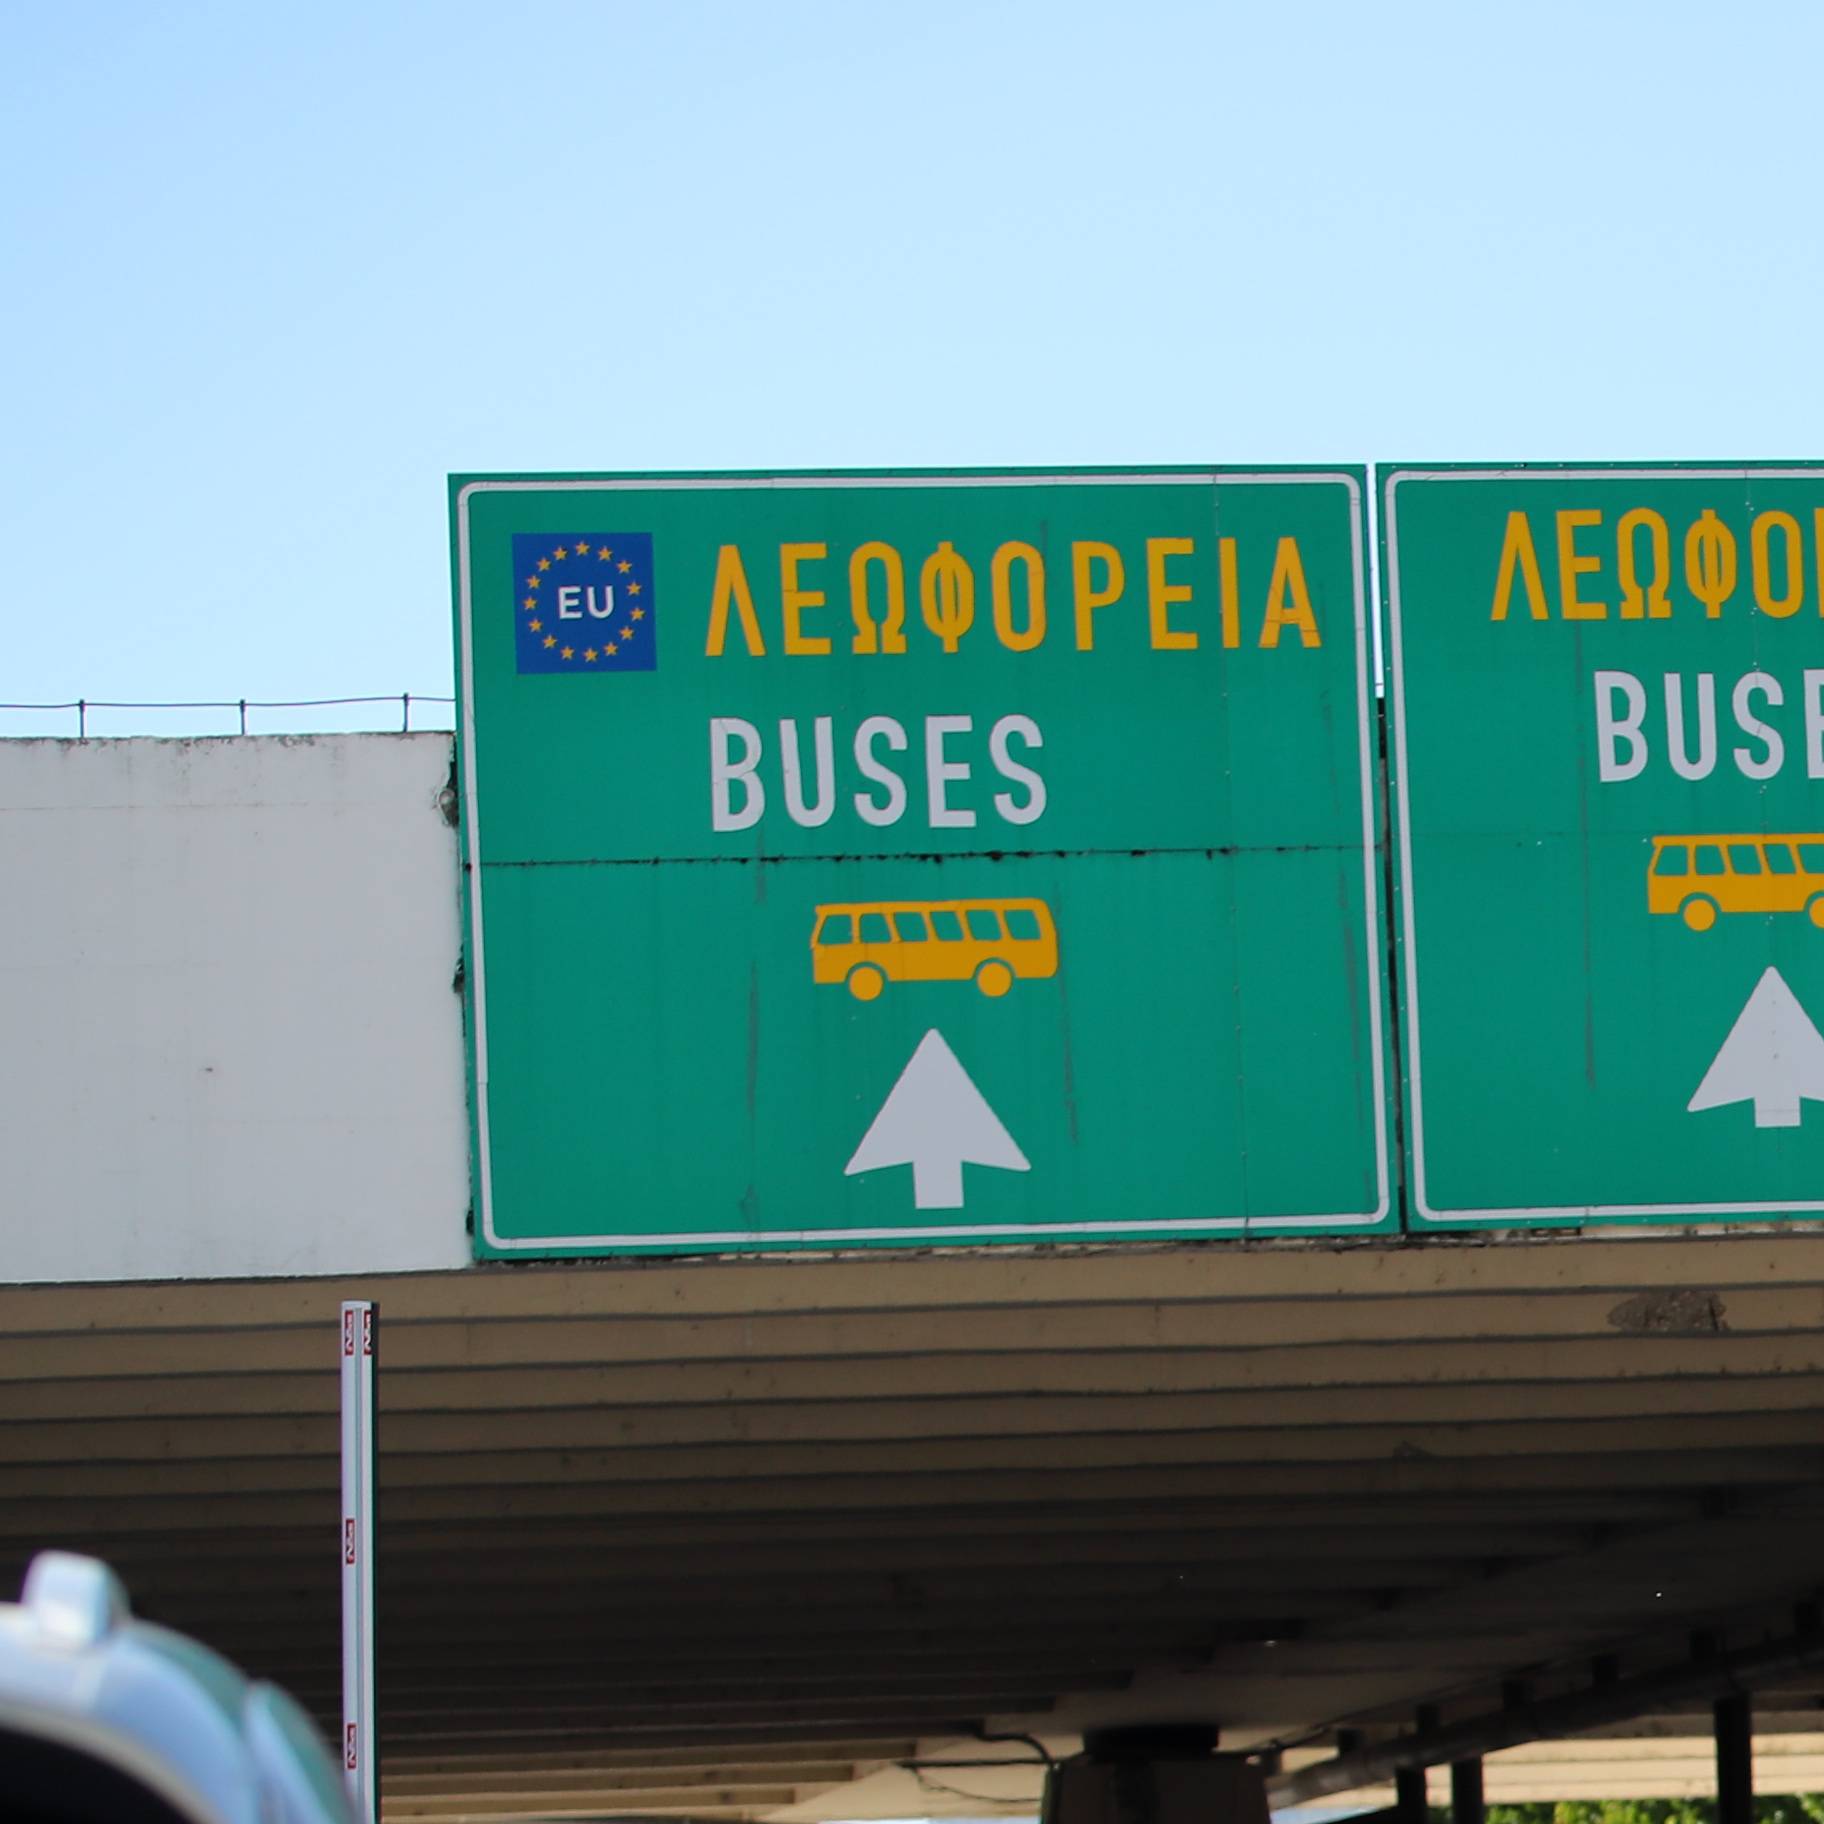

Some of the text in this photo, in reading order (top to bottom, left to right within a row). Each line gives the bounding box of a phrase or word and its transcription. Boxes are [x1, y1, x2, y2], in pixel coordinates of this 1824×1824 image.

[557, 585, 614, 620] EU
[705, 536, 1322, 657] ΛΕΩΦΟΡΕΙΑ
[710, 714, 1048, 832] BUSES
